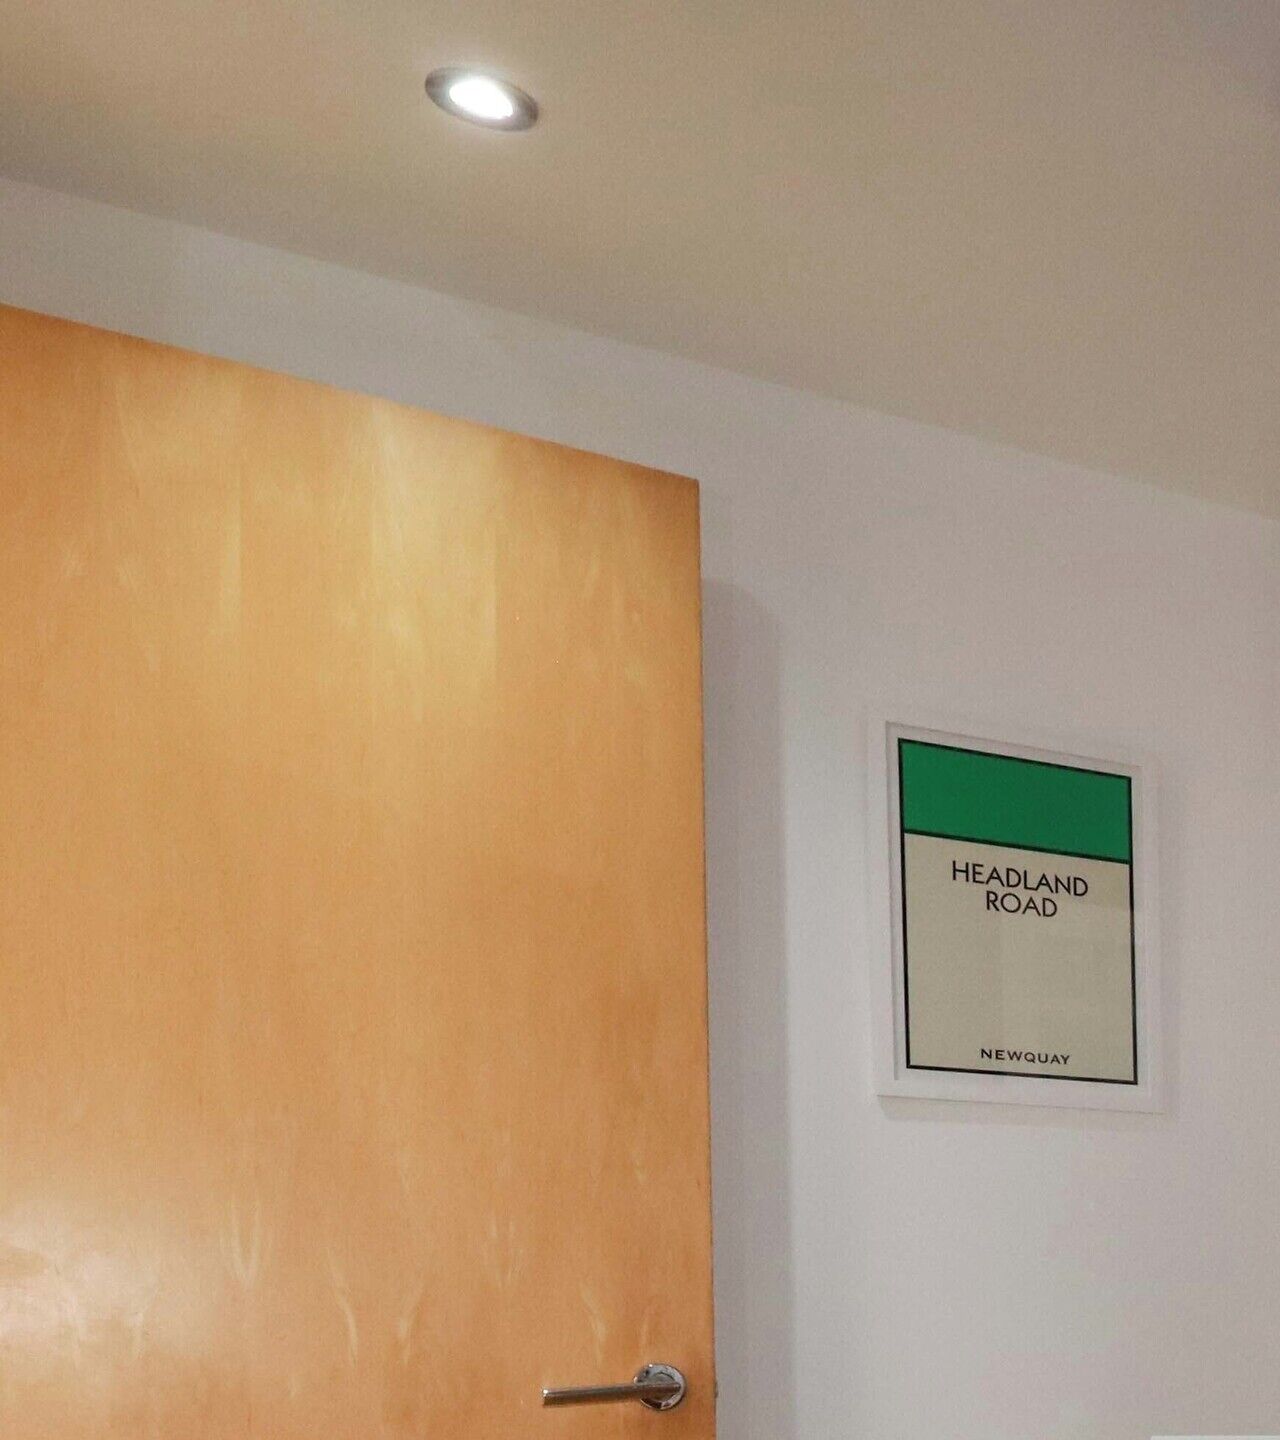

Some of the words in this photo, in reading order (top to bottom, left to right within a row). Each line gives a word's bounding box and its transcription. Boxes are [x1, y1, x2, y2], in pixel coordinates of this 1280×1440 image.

[951, 859, 1090, 898] HEADLAND
[985, 889, 1058, 918] ROAD
[980, 1047, 1071, 1066] NEWQUAY
